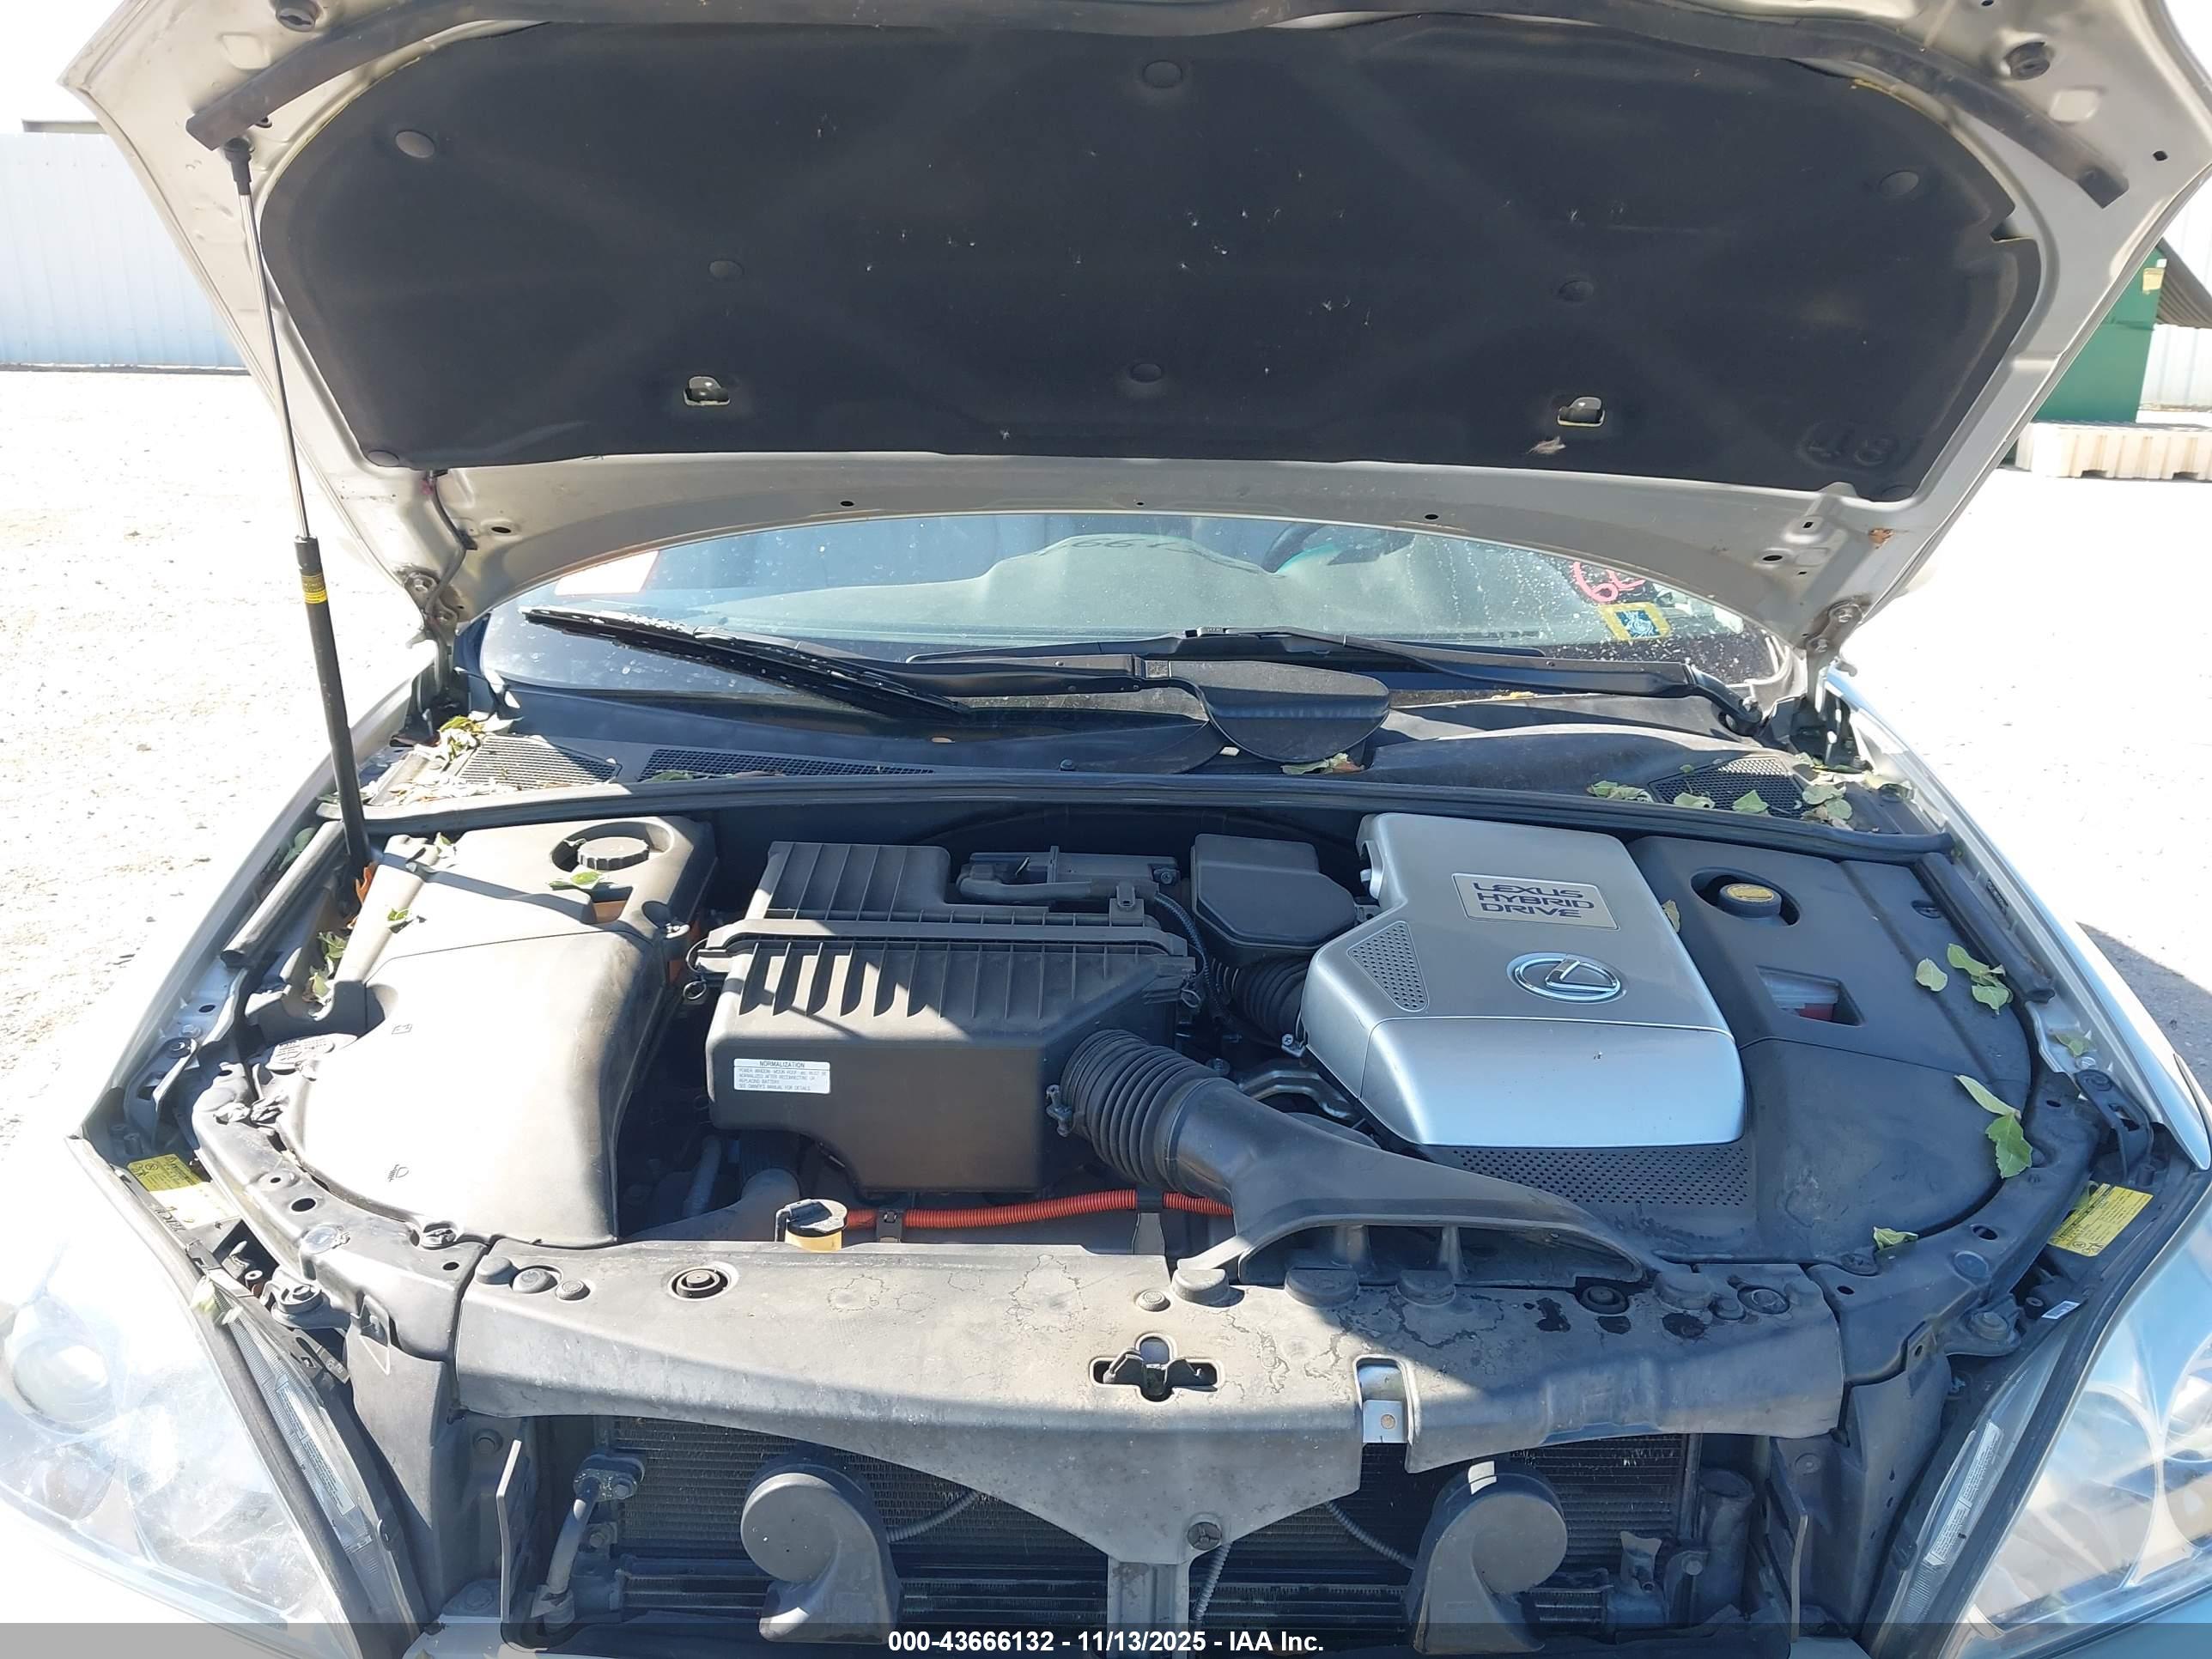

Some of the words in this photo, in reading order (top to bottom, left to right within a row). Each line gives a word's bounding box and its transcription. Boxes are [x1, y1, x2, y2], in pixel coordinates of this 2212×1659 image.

[1473, 882, 1583, 898] LEXUS
[1477, 892, 1595, 909] HYBRID
[1480, 902, 1582, 919] DRIVE
